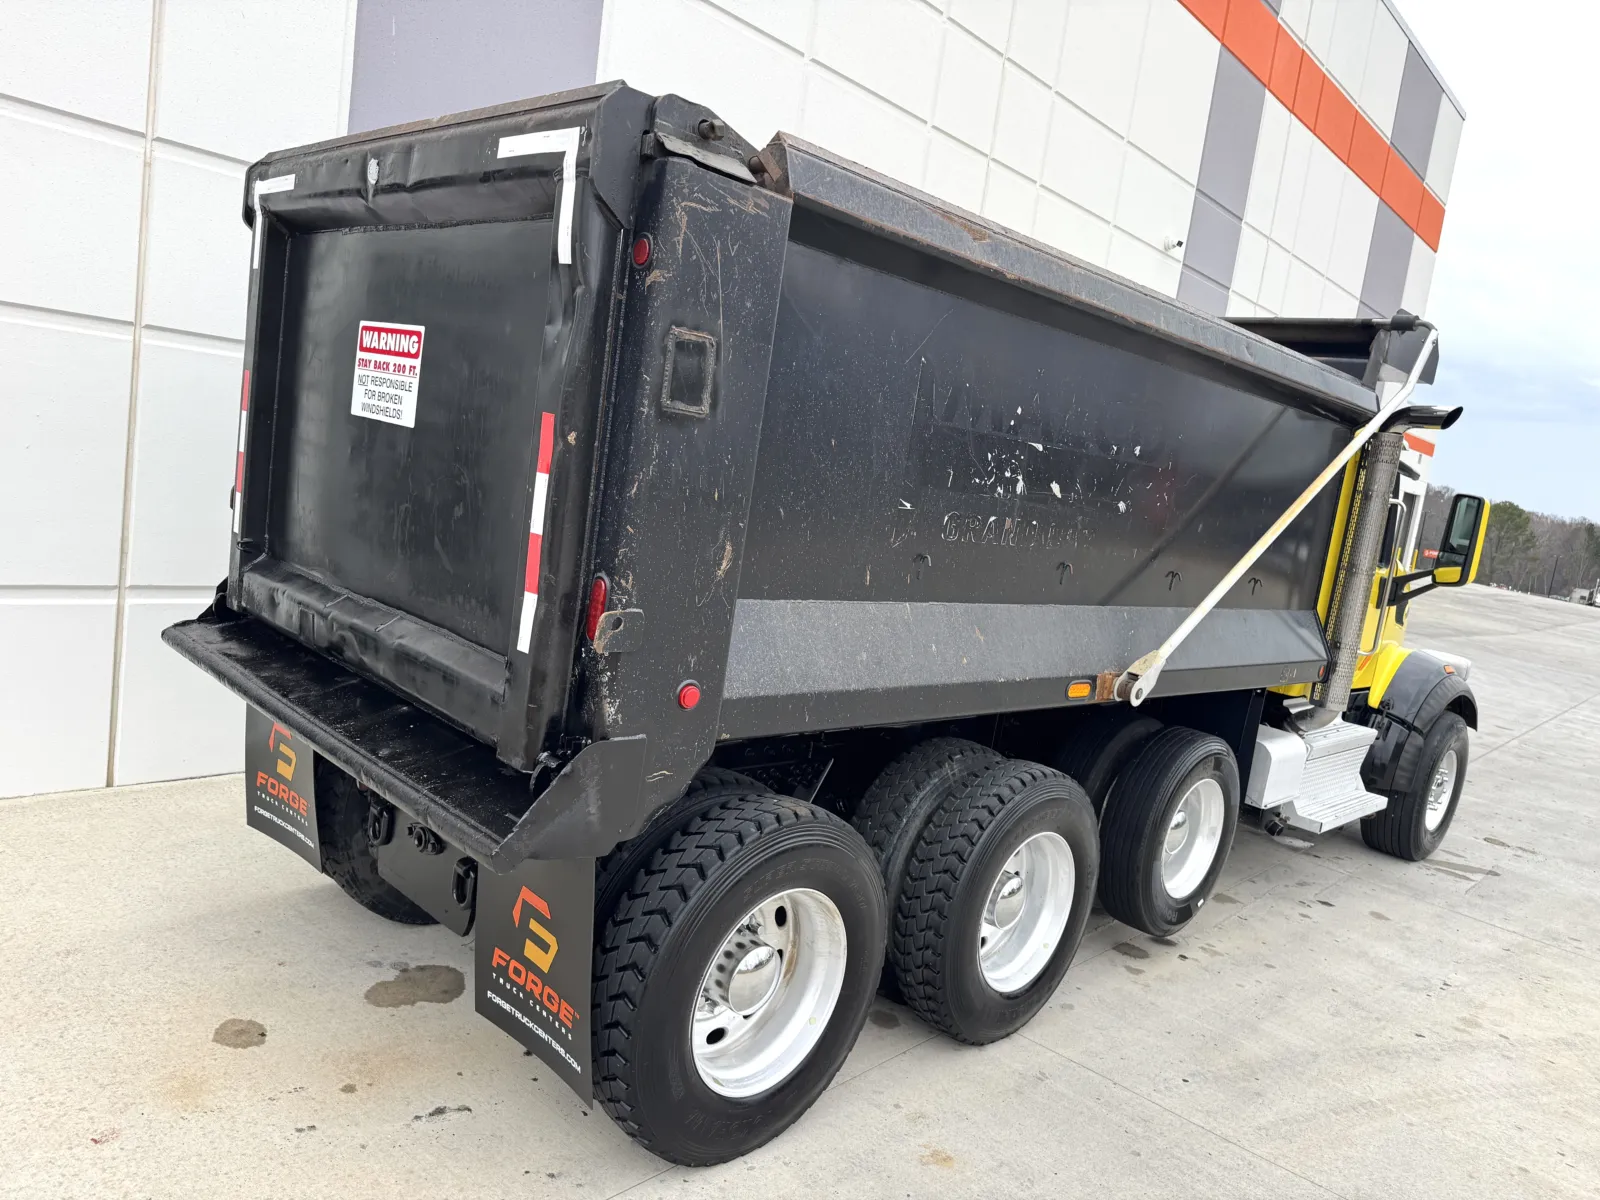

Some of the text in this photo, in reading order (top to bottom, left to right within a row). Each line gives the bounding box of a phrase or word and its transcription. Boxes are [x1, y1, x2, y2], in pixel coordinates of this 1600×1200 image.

[362, 330, 419, 354] WARNING
[357, 358, 418, 376] STAY BACK 200 FT.
[358, 374, 413, 392] NOT RESPONSIBLE
[361, 402, 403, 419] WINDSHIELDS!
[364, 389, 403, 405] FOR BROKEN
[256, 771, 308, 816] FORGE
[254, 805, 315, 849] FORGETRUCKCENTERS.COM
[491, 947, 574, 1029] FORGE
[492, 972, 572, 1041] TRUCK CENTERS
[487, 990, 582, 1074] FORGETRUCKCENTERS.COM
